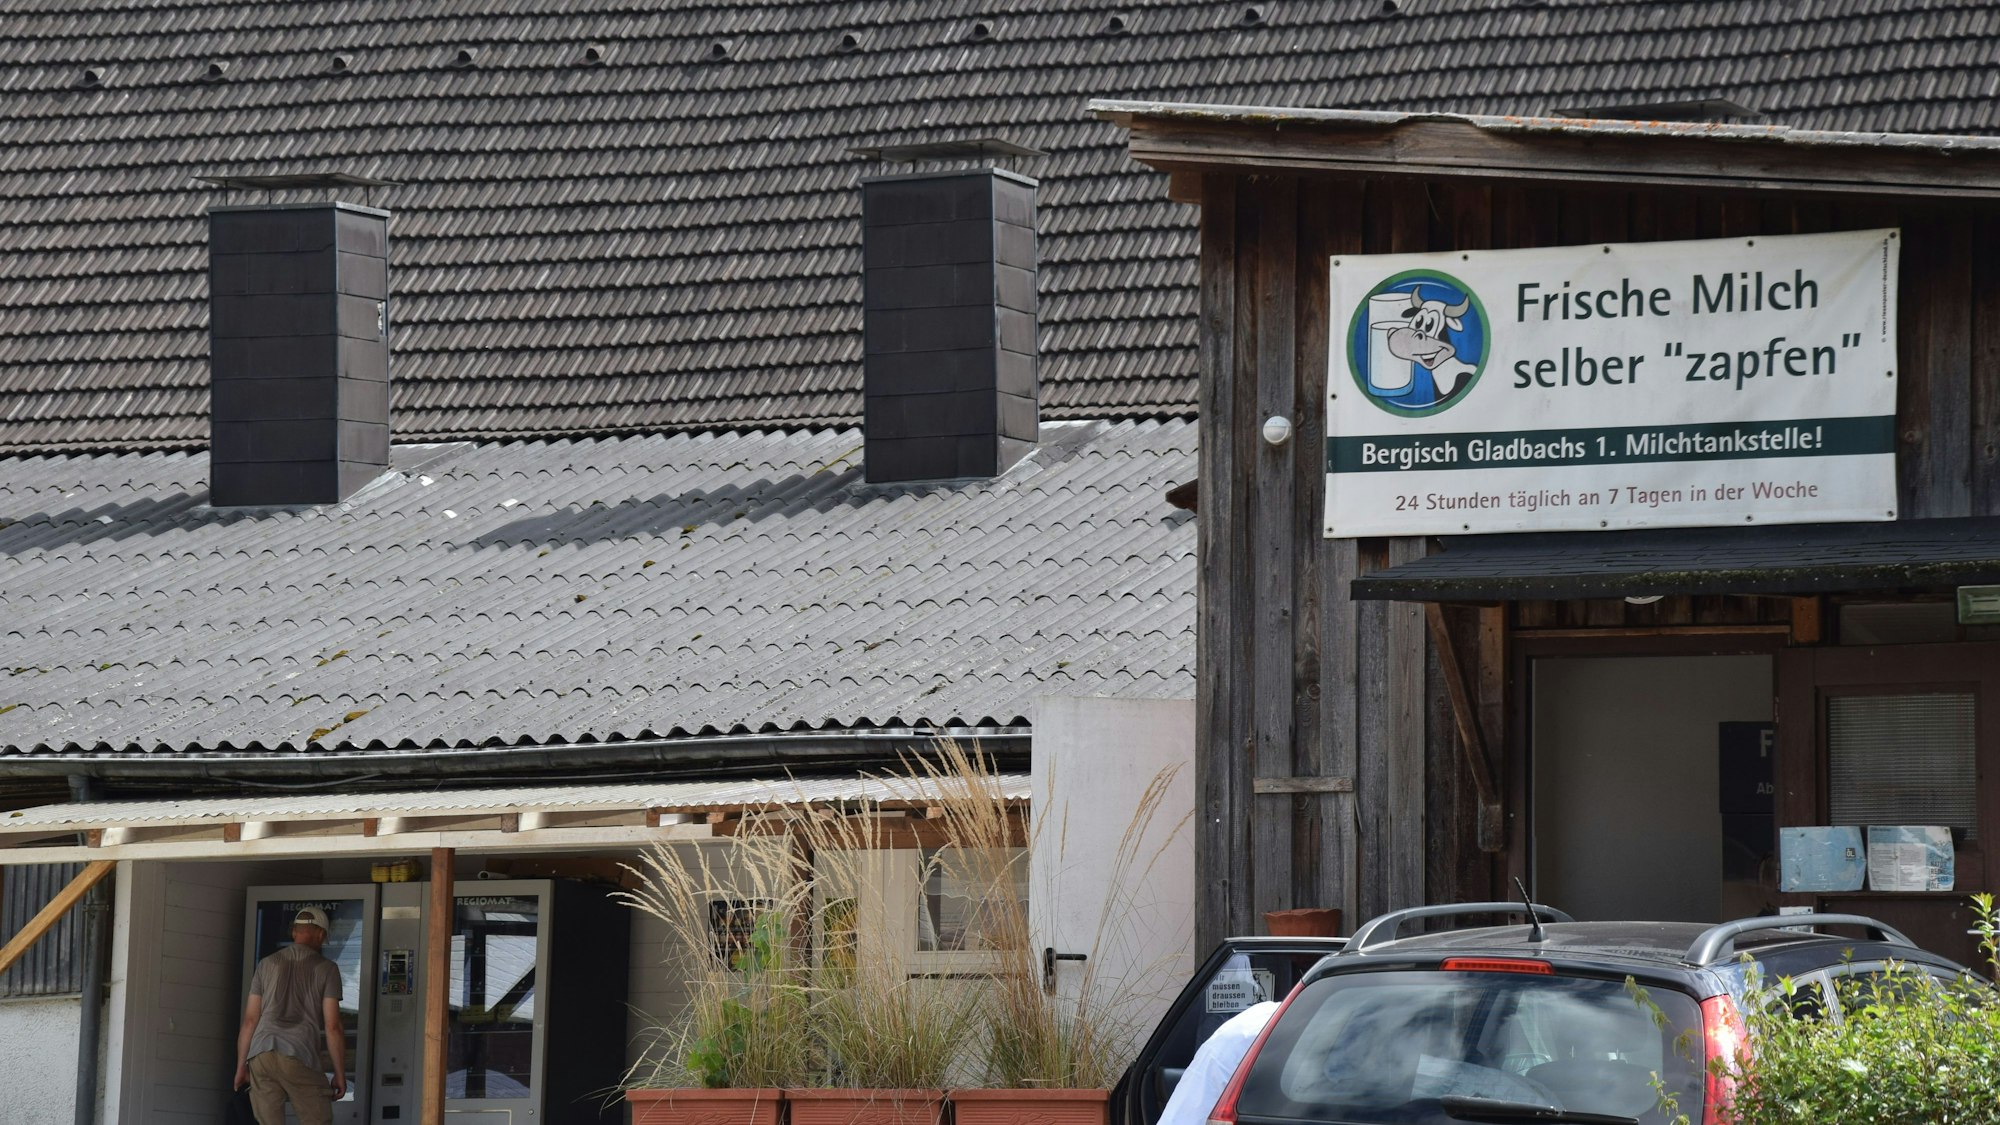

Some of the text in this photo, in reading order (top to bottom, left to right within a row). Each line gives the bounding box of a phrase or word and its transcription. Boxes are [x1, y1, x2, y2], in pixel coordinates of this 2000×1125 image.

[1517, 269, 1819, 322] Frische Milch
[1513, 332, 1862, 391] selber "zapfen"
[1362, 426, 1823, 469] Bergisch Gladbachs 1. Milchtankstelle!
[1395, 481, 1818, 512] 24 Stunden täglich an 7 Tagen in der Woche
[457, 897, 511, 906] REGIOMAT
[1212, 992, 1246, 1000] draussen
[1212, 1001, 1240, 1009] bleiben
